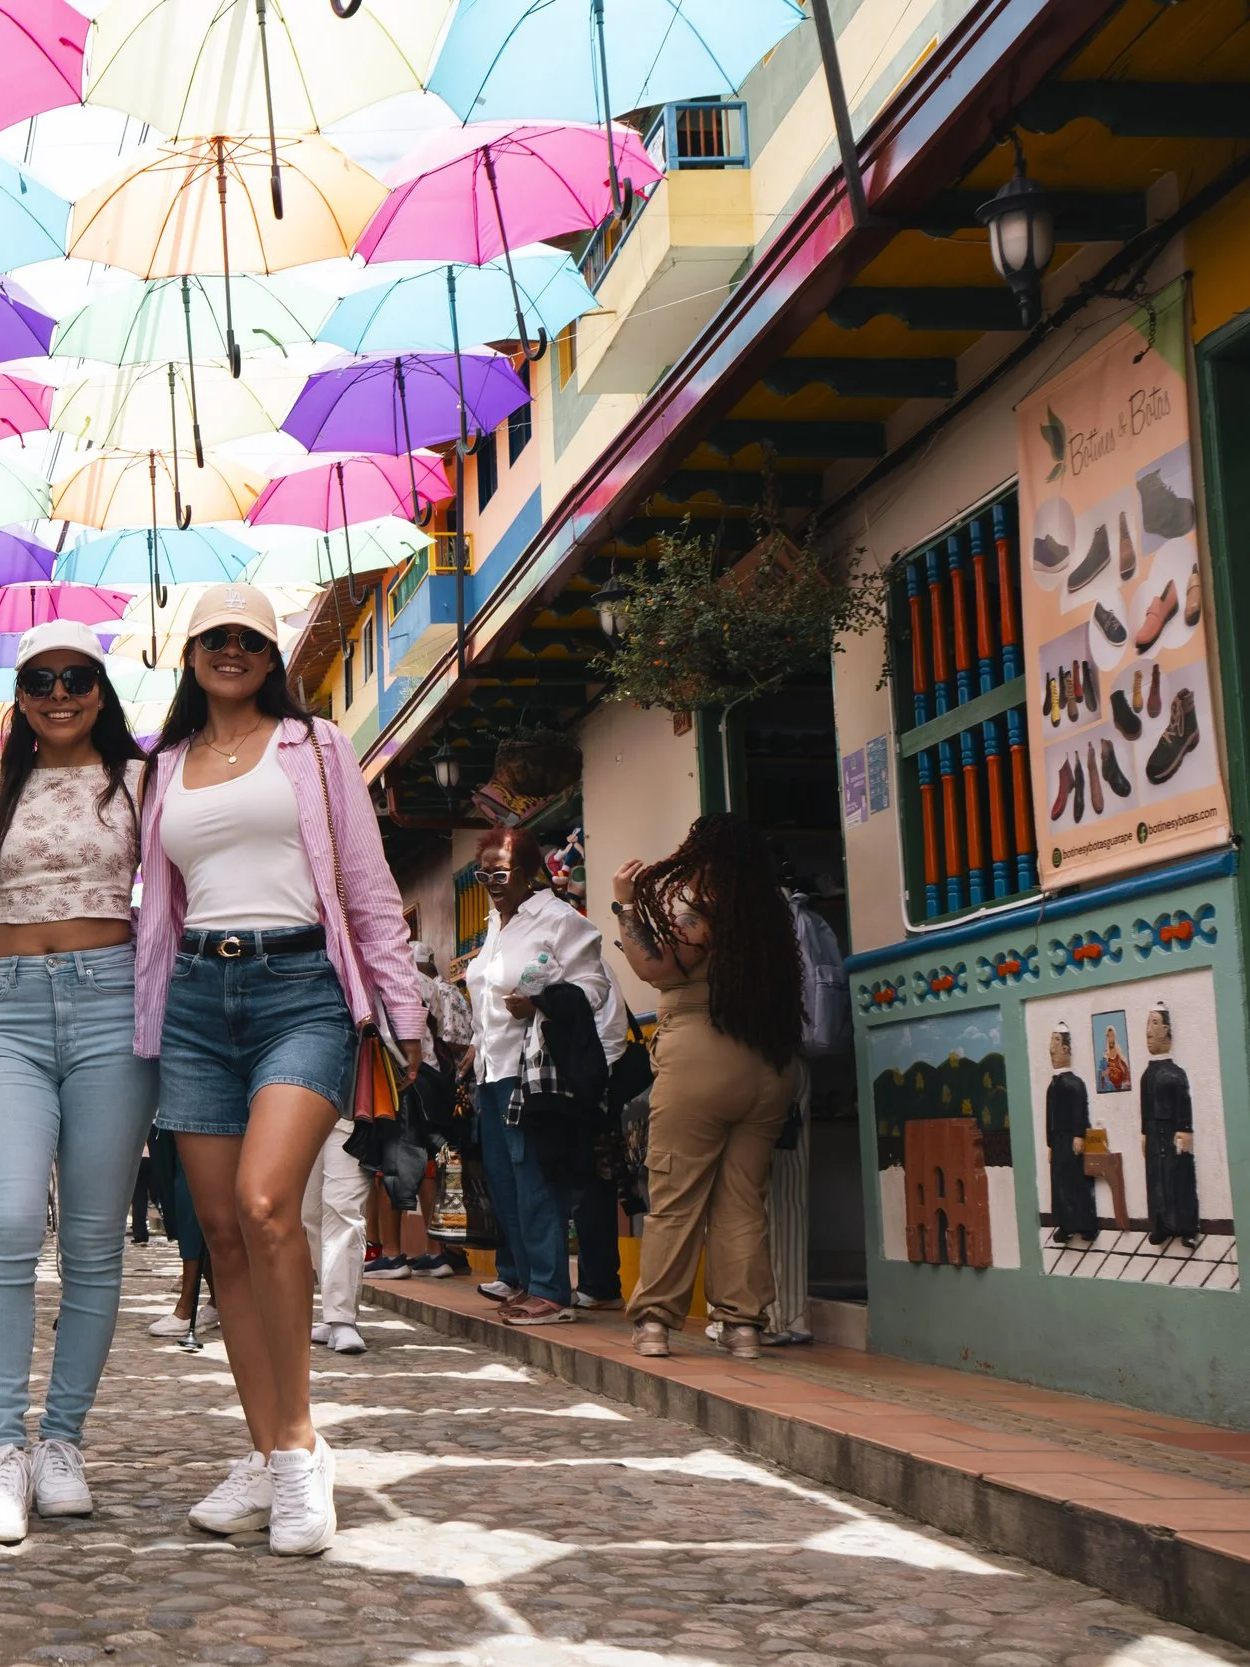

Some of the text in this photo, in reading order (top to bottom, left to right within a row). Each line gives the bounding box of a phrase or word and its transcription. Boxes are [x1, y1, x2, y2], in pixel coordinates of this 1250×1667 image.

[1068, 386, 1171, 476] Botines & Botas
[224, 588, 246, 609] LA
[1148, 807, 1218, 836] botinesybotas.com
